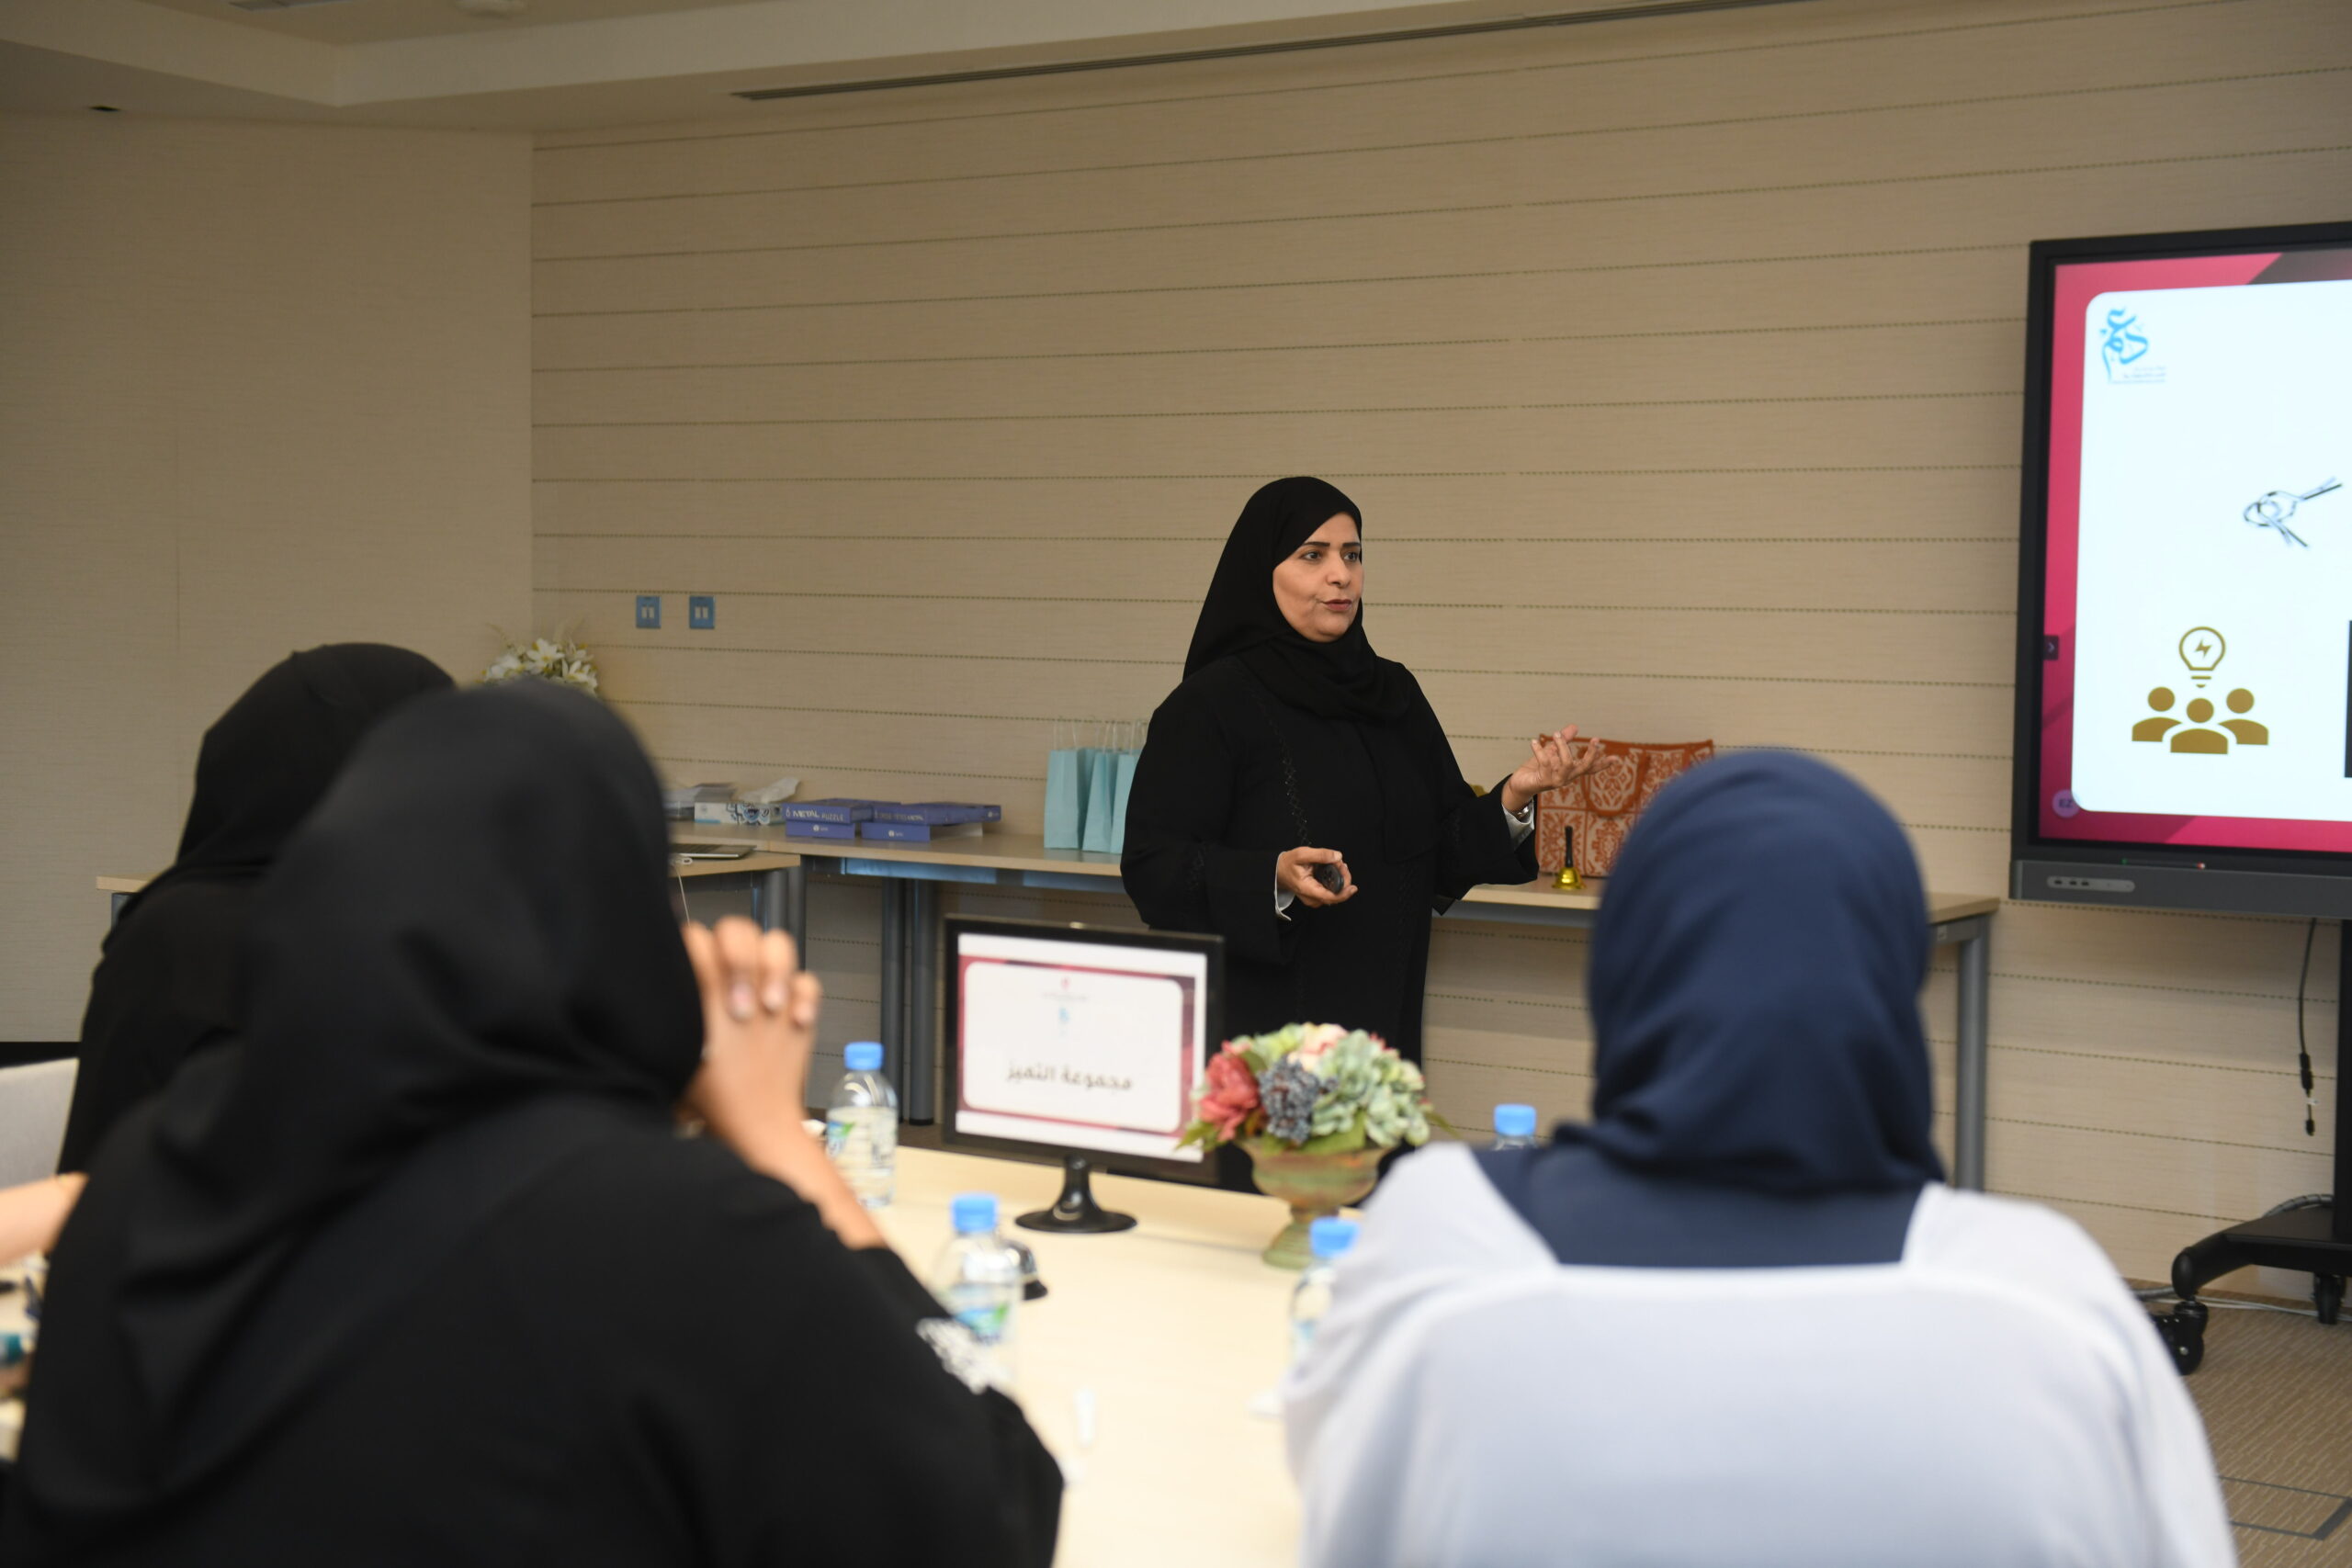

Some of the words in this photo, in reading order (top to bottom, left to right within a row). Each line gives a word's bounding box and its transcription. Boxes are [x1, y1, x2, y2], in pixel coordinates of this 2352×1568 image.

[793, 809, 820, 818] METAL
[1007, 1061, 1056, 1083] التميز
[1061, 1066, 1133, 1093] مجموعة
